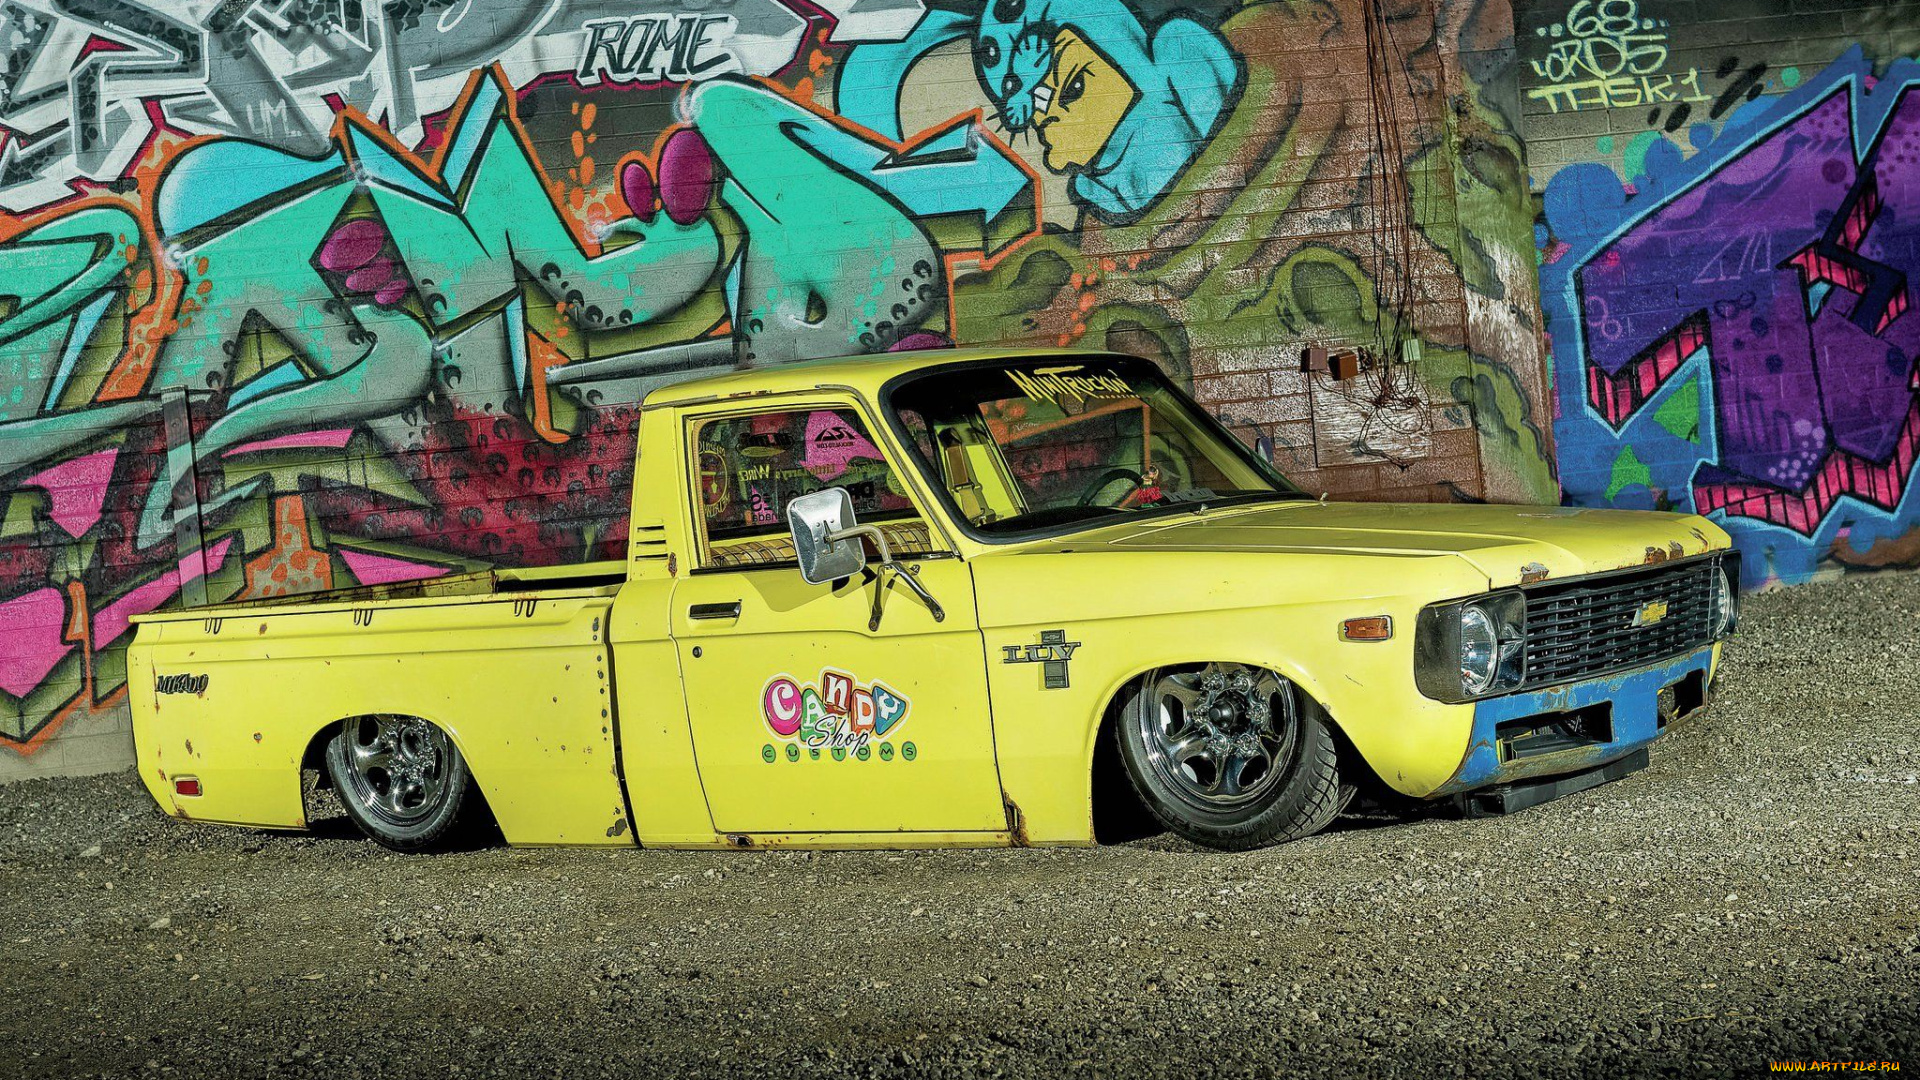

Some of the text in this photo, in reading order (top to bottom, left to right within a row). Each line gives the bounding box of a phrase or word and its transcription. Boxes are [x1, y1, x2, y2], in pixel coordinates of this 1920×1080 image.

[579, 16, 732, 79] ROME
[155, 673, 209, 694] MIKADO
[807, 714, 869, 756] Shop
[763, 745, 916, 761] CUSTOMS
